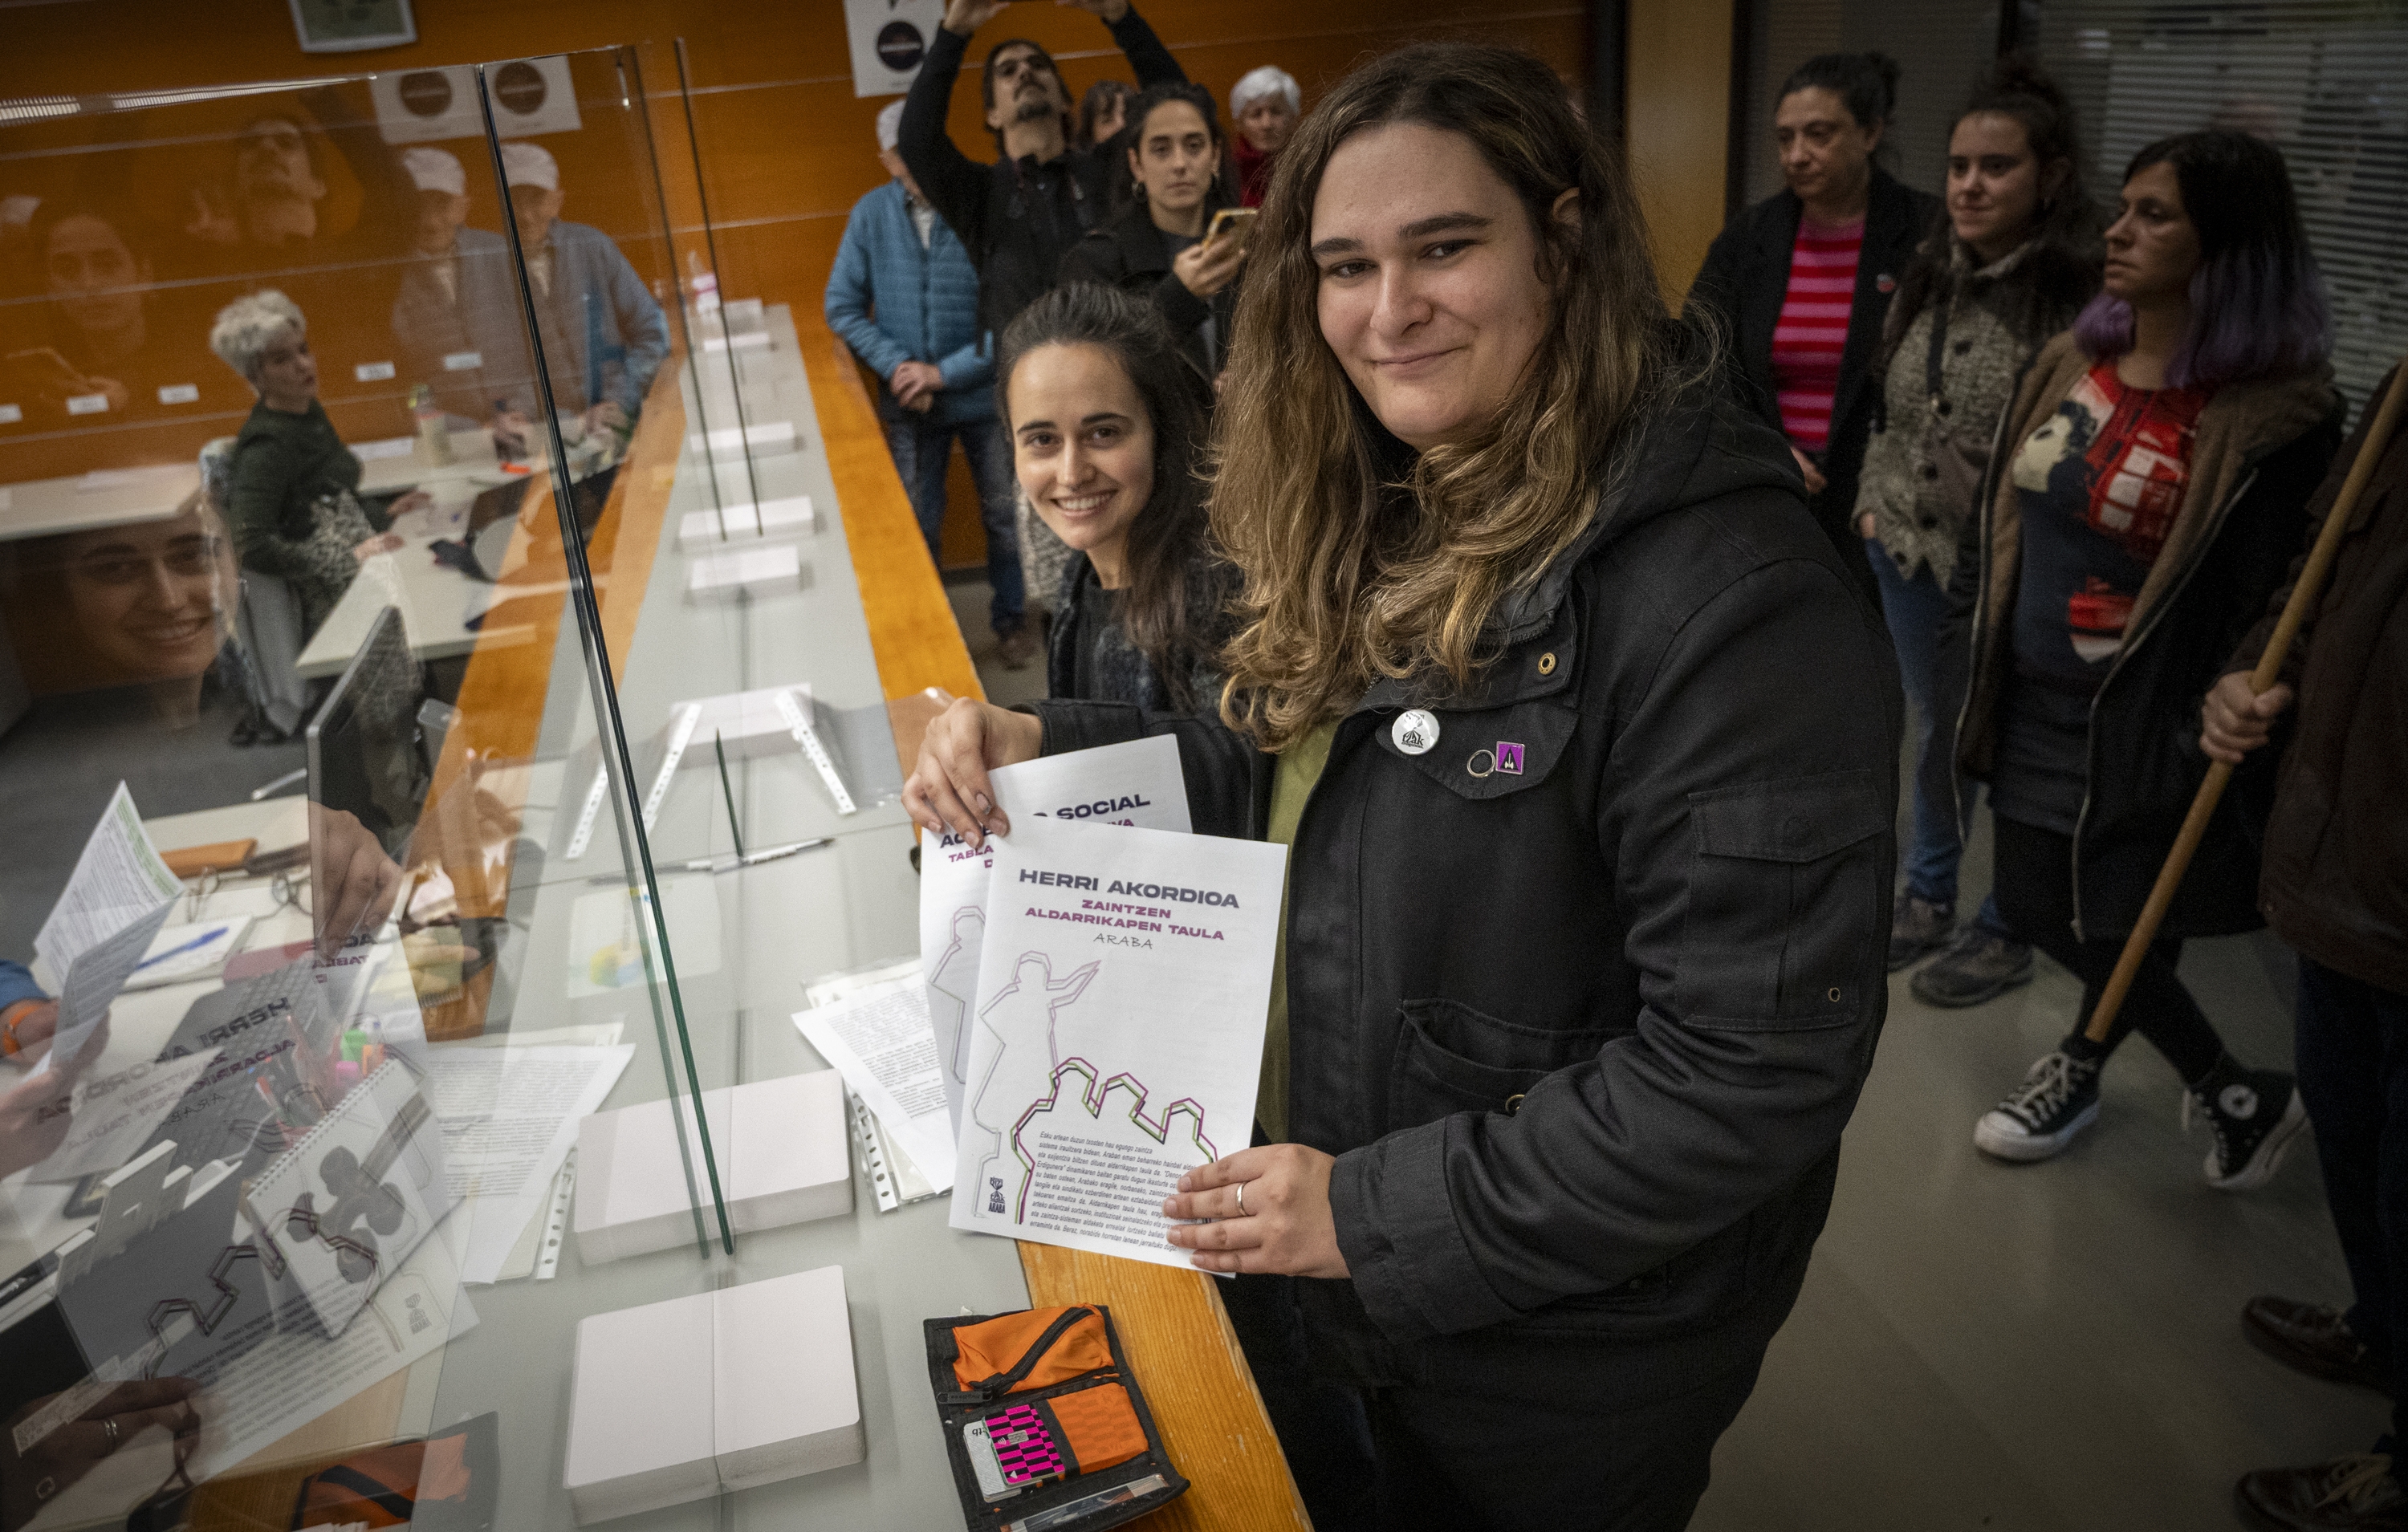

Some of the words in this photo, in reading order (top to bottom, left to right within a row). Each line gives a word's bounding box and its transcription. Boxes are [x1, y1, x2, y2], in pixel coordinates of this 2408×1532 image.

[1056, 794, 1151, 820] SOCIAL
[949, 844, 995, 863] TABLA
[1019, 868, 1099, 892] HERRI
[1107, 880, 1240, 908] AKORDIOA
[1081, 899, 1171, 919] ZAINTZEN
[1025, 907, 1162, 933] ALDARRIKAPEN
[1168, 924, 1225, 941] TAULA
[1092, 933, 1153, 949] ARABA
[1039, 1131, 1052, 1139] Esku
[1070, 1136, 1085, 1144] duzun
[1085, 1138, 1104, 1147] txosten
[1135, 1146, 1153, 1154] zaintza
[1039, 1141, 1058, 1149] sistema
[1103, 1151, 1121, 1159] Araban
[988, 1202, 1005, 1214] ARABA
